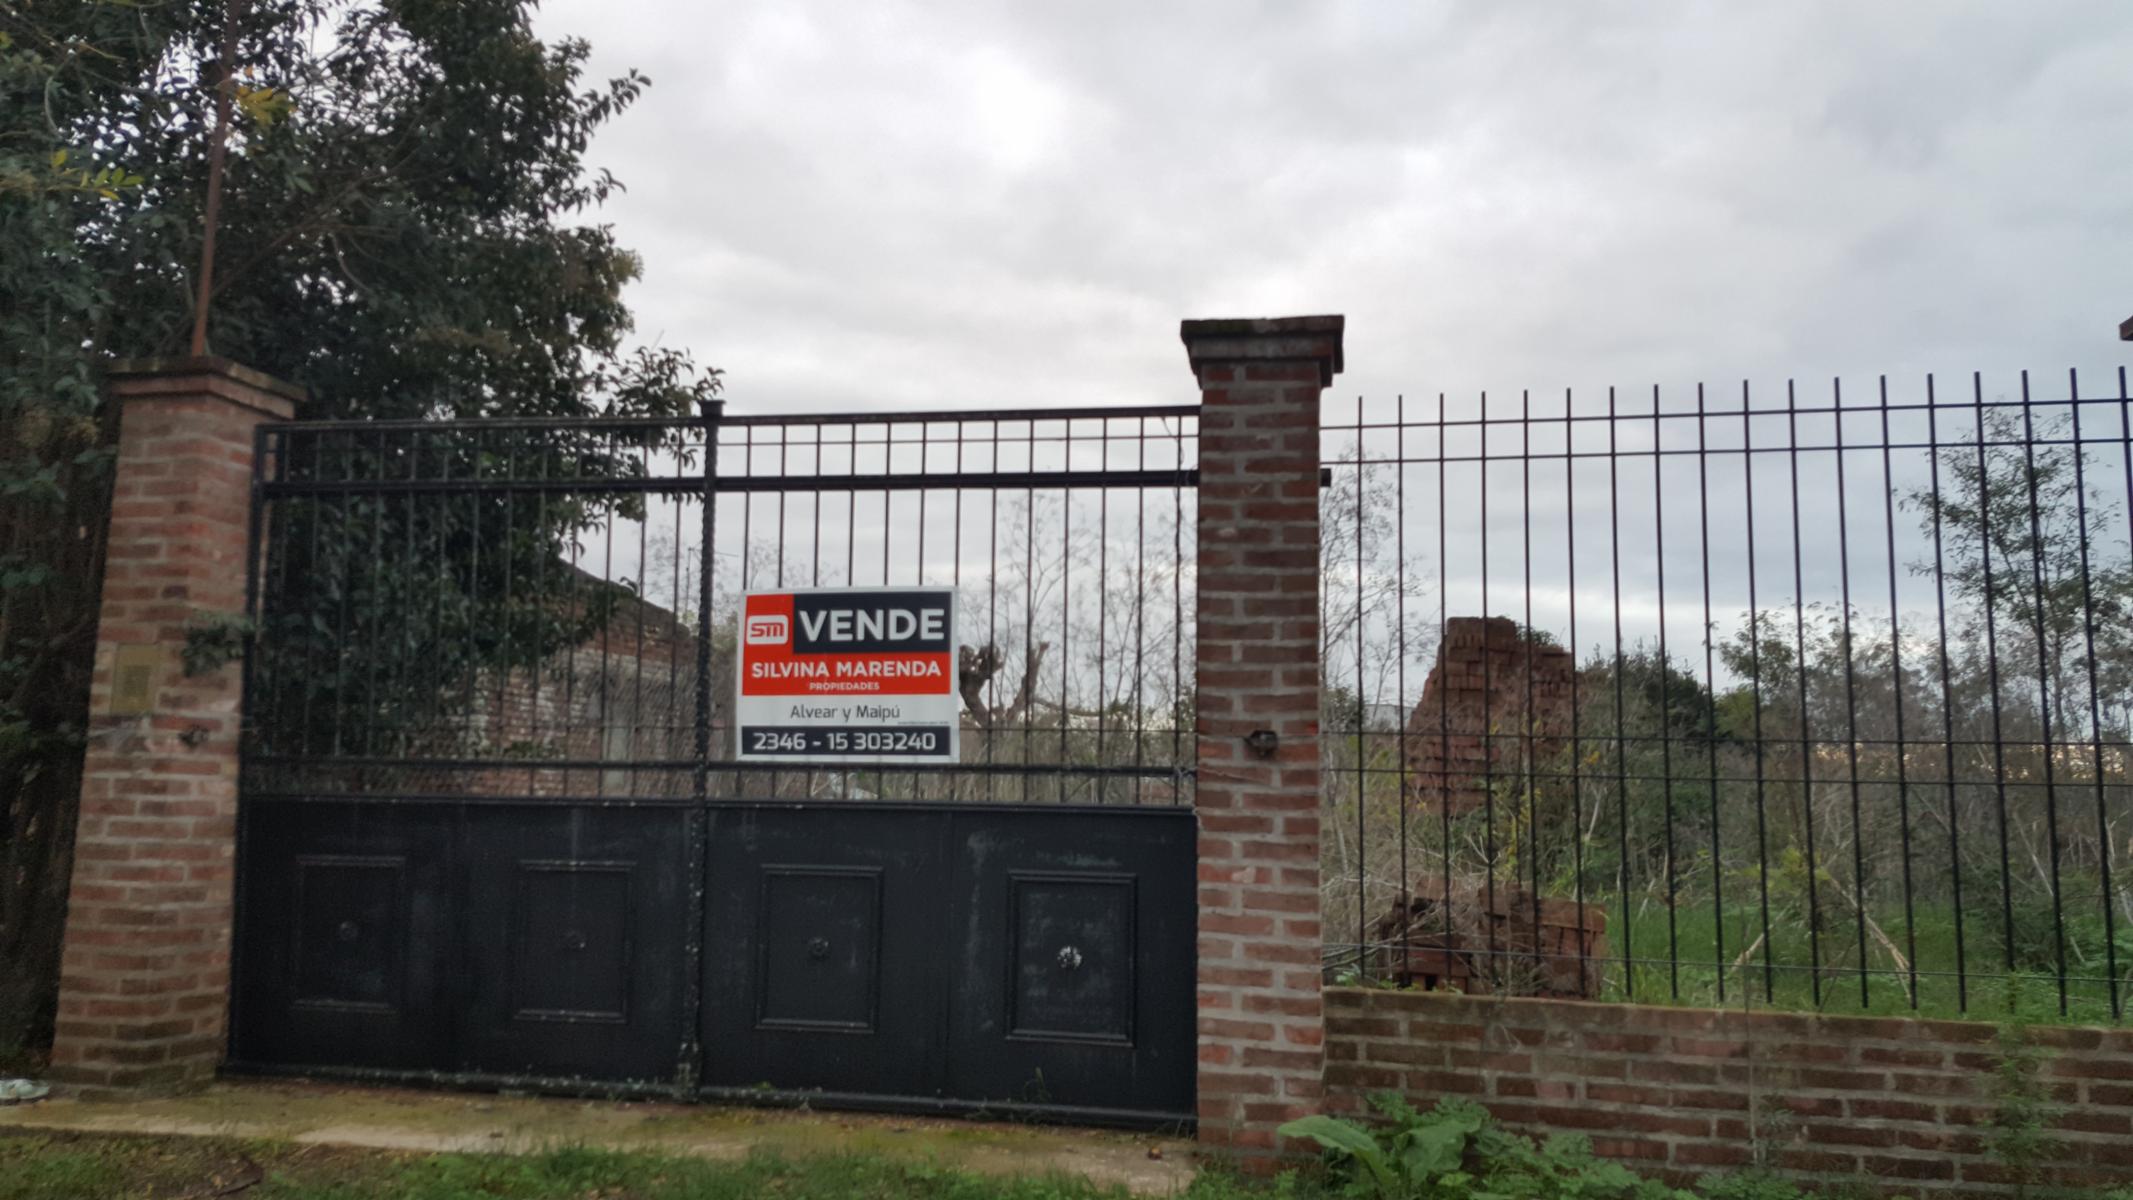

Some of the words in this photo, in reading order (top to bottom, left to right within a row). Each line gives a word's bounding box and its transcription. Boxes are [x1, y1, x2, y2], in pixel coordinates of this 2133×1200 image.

[799, 608, 944, 642] VENDE
[751, 662, 830, 678] SILVINA
[836, 661, 941, 677] MARENDA
[809, 682, 880, 690] PROPIEDADES
[790, 705, 838, 718] Alvear
[843, 708, 851, 722] y
[856, 704, 900, 722] Maipú
[753, 733, 806, 750] 2346
[827, 733, 848, 749] 15
[854, 733, 936, 750] 303240
